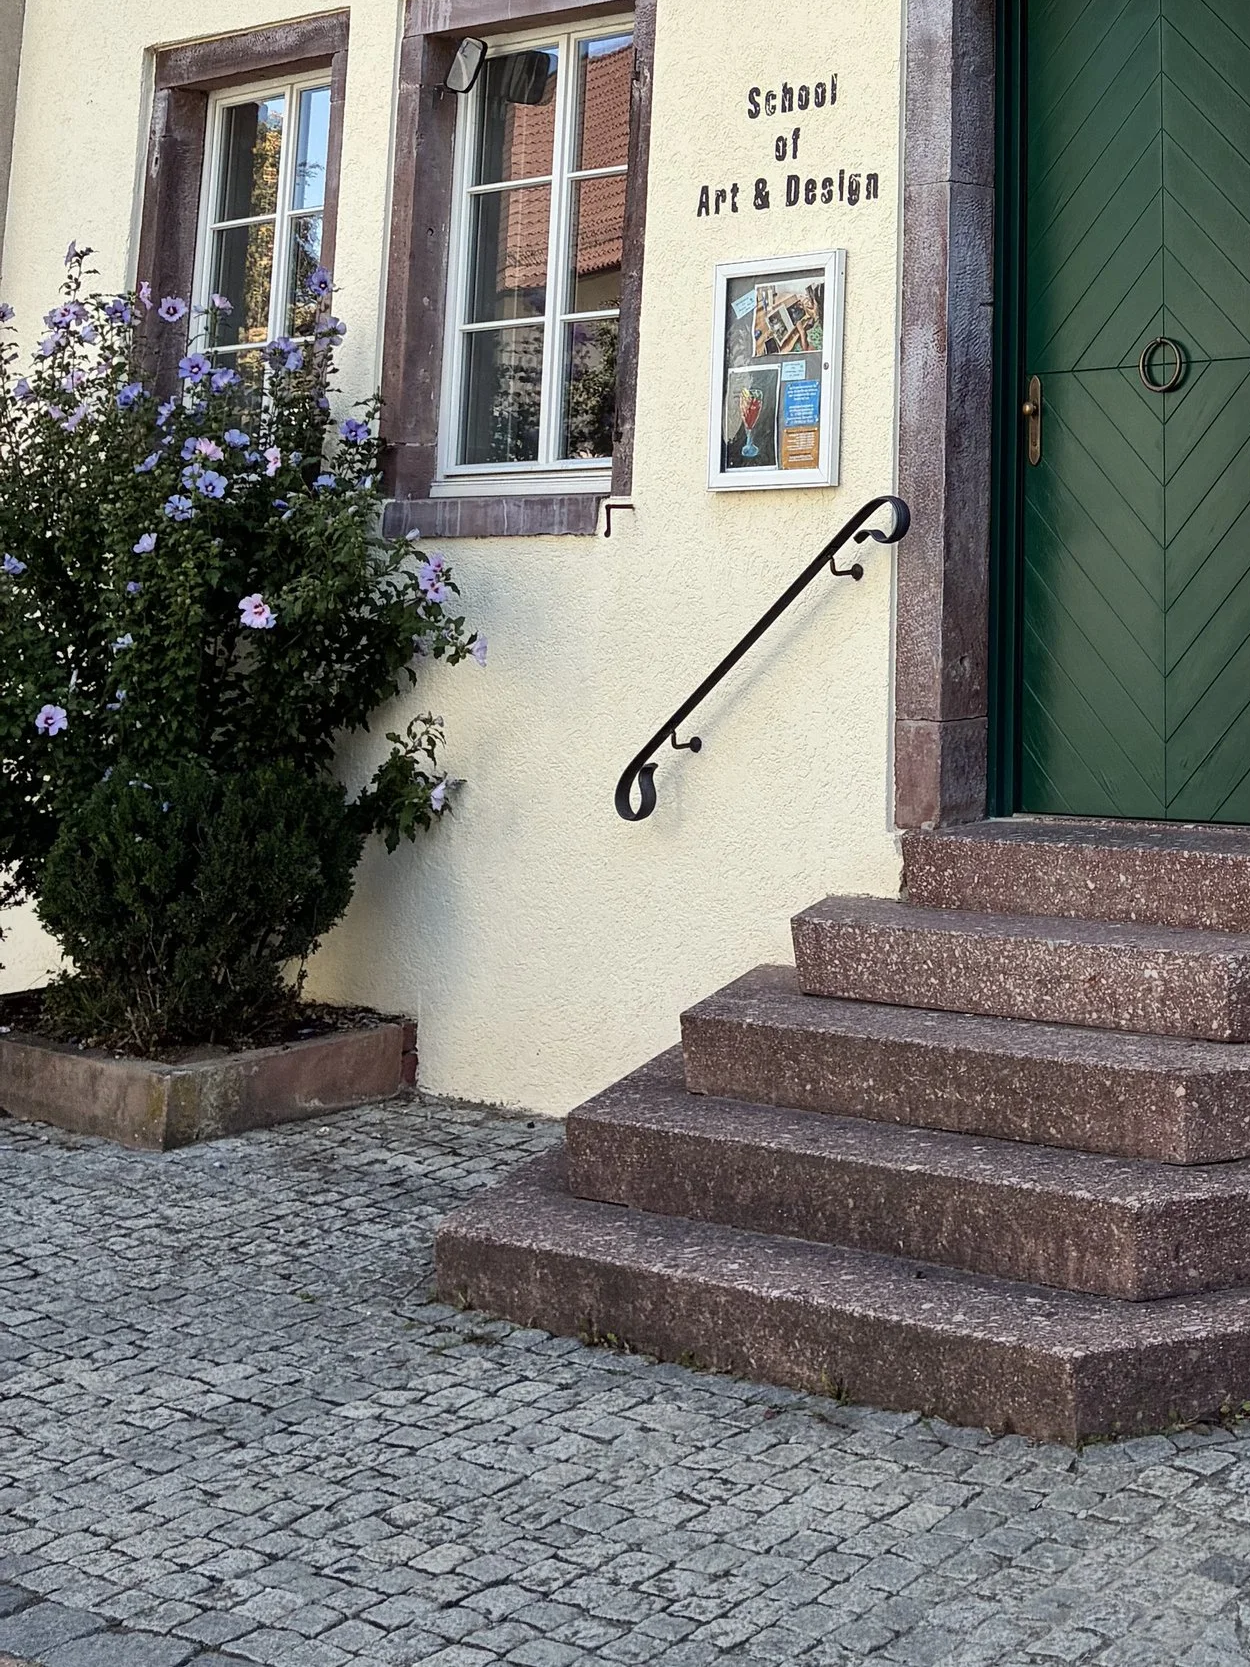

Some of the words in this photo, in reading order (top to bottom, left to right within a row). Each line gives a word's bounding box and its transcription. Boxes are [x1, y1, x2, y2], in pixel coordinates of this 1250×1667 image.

[747, 73, 838, 119] School
[775, 127, 800, 161] of
[696, 183, 740, 217] Art
[753, 177, 770, 210] &
[785, 169, 879, 207] Design
